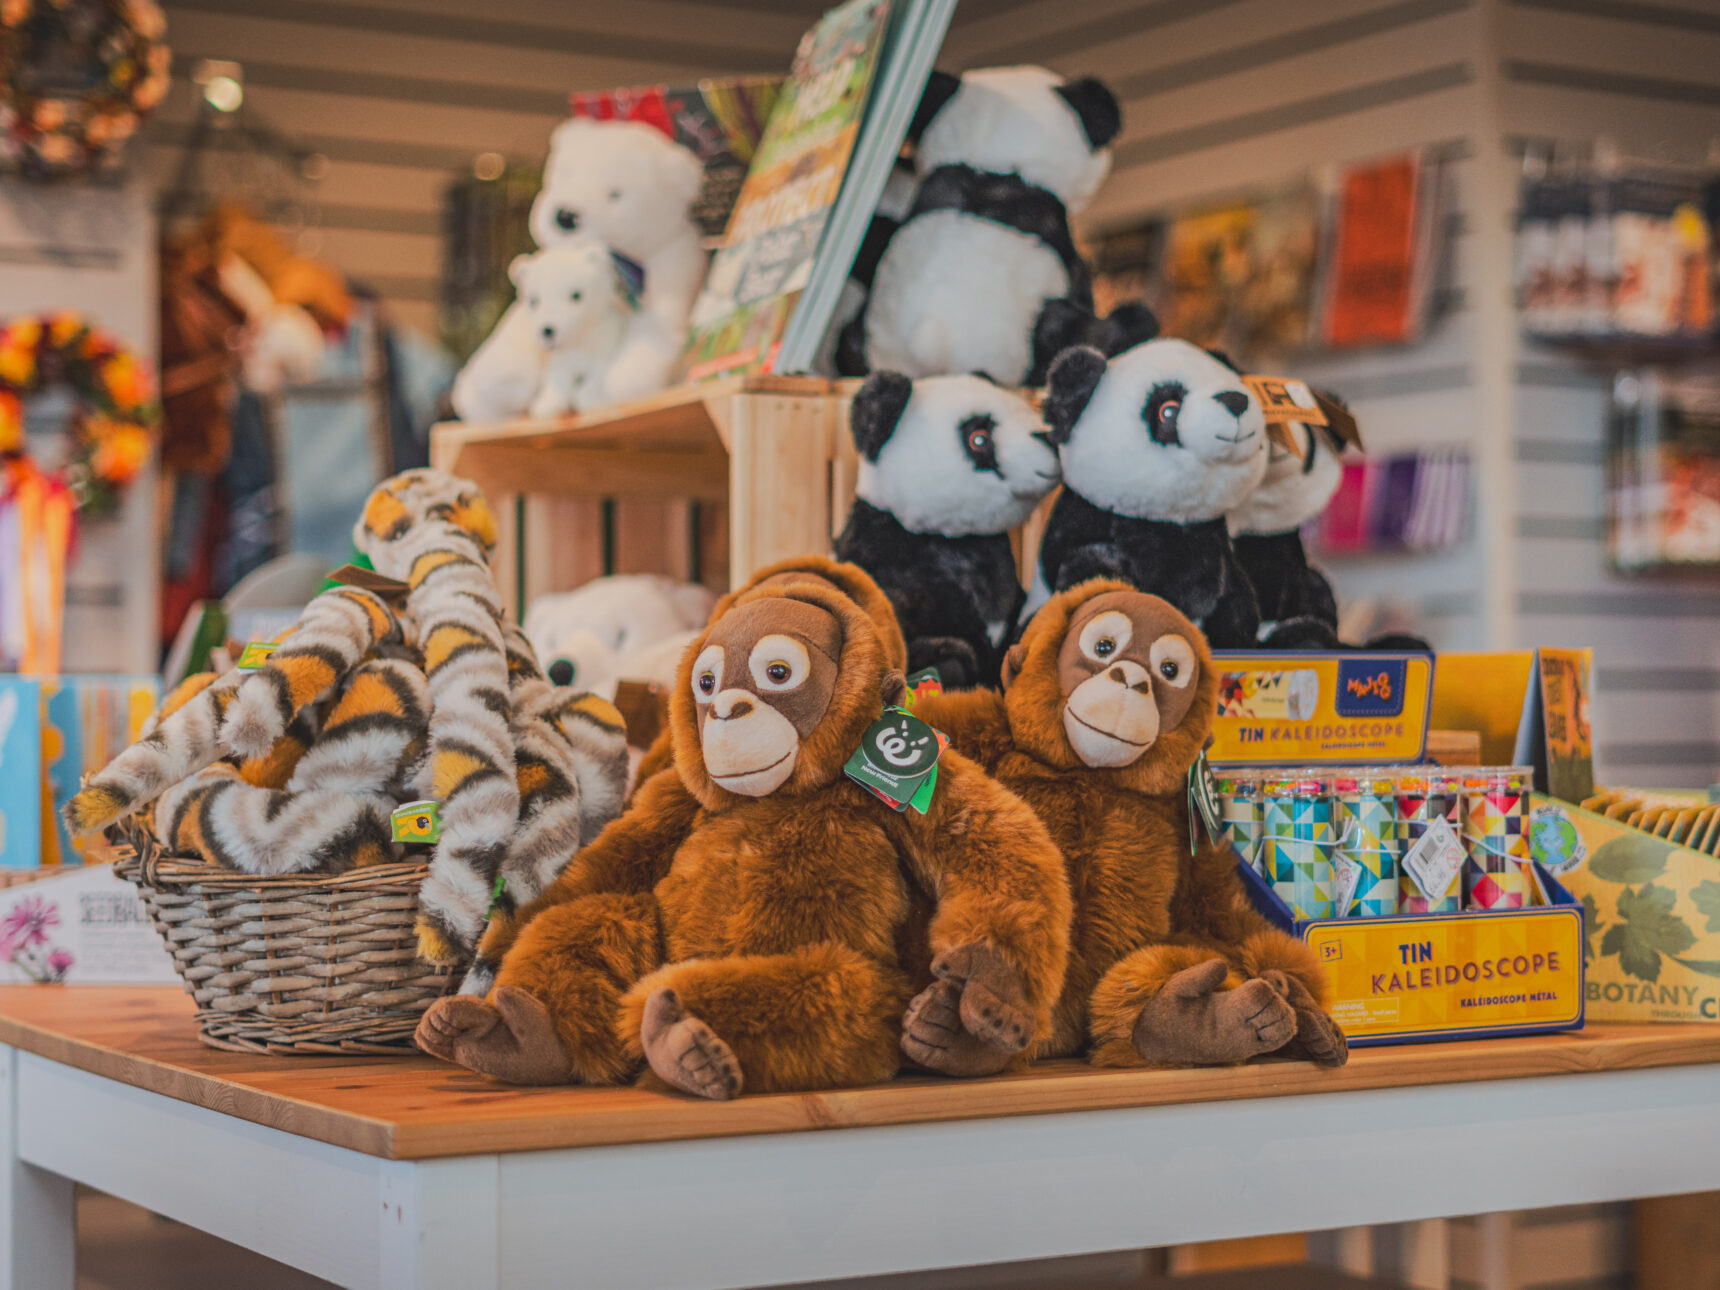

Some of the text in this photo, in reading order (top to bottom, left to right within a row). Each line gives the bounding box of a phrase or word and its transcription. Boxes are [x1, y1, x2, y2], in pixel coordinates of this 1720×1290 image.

[1239, 722, 1404, 742] TIN KALEIDOSCOPE
[1324, 946, 1337, 958] 3+
[1398, 941, 1433, 965] TIN
[1371, 952, 1561, 995] KALEIDOSCOPE
[1586, 982, 1699, 1006] BOTANY
[1700, 997, 1720, 1019] C
